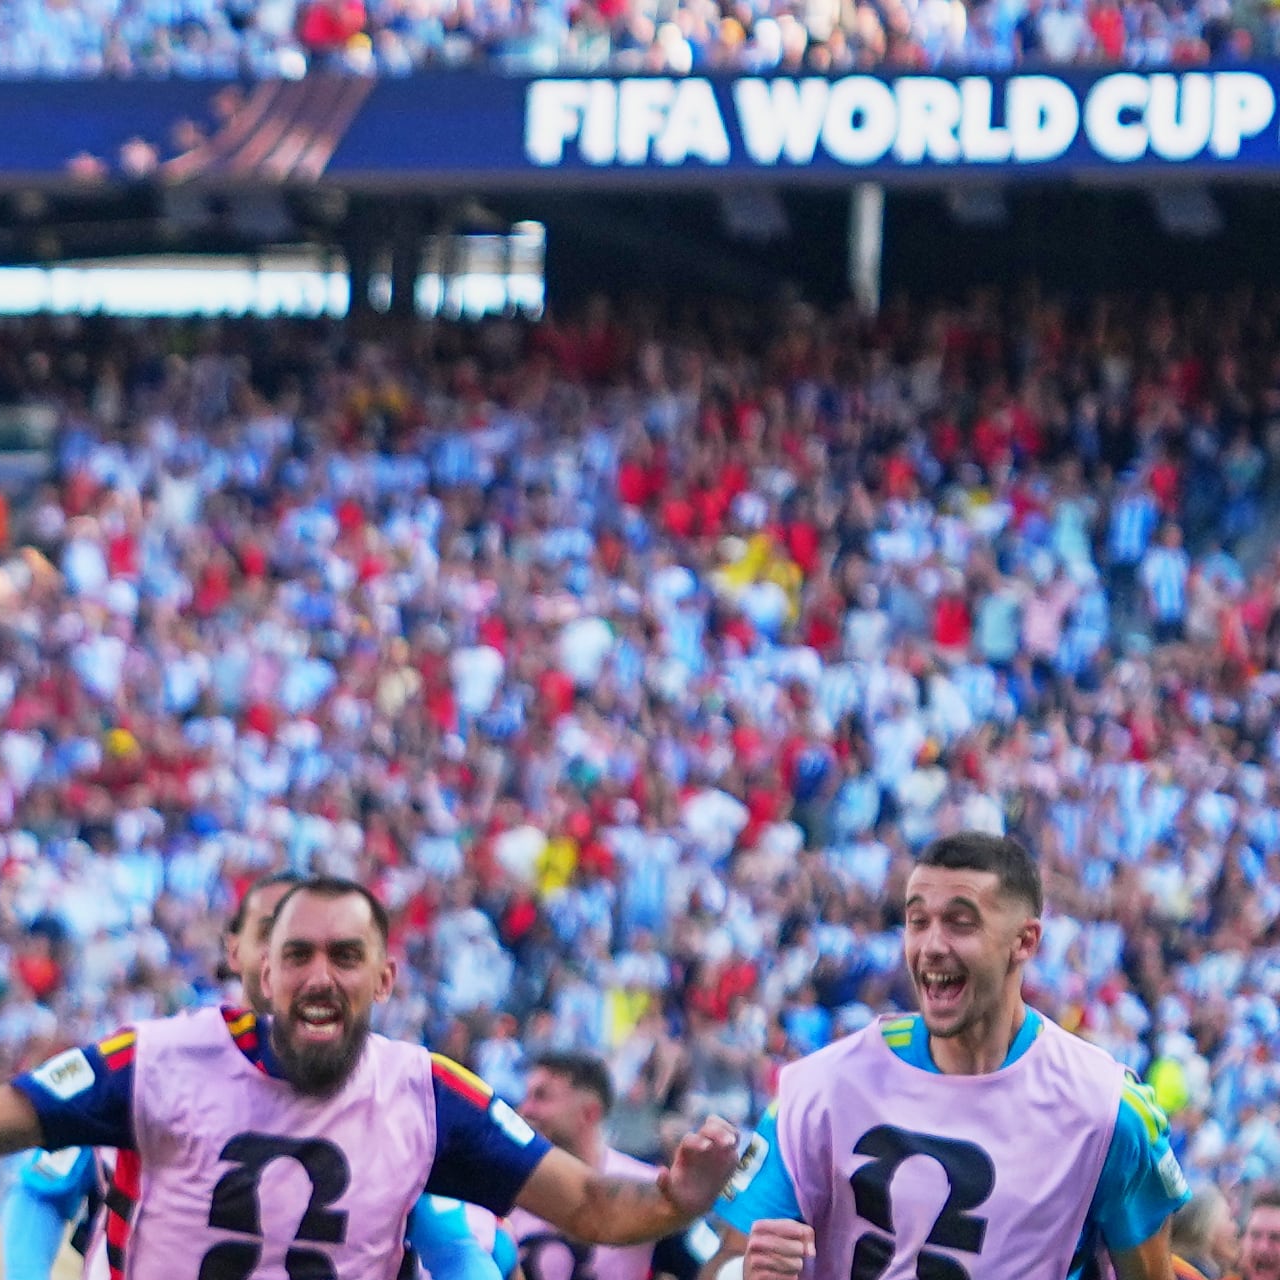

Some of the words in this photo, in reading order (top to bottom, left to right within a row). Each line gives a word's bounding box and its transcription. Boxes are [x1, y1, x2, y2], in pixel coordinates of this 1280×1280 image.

[525, 78, 731, 167] FIFA
[733, 76, 1079, 166] WORLD
[1084, 73, 1278, 161] CUP
